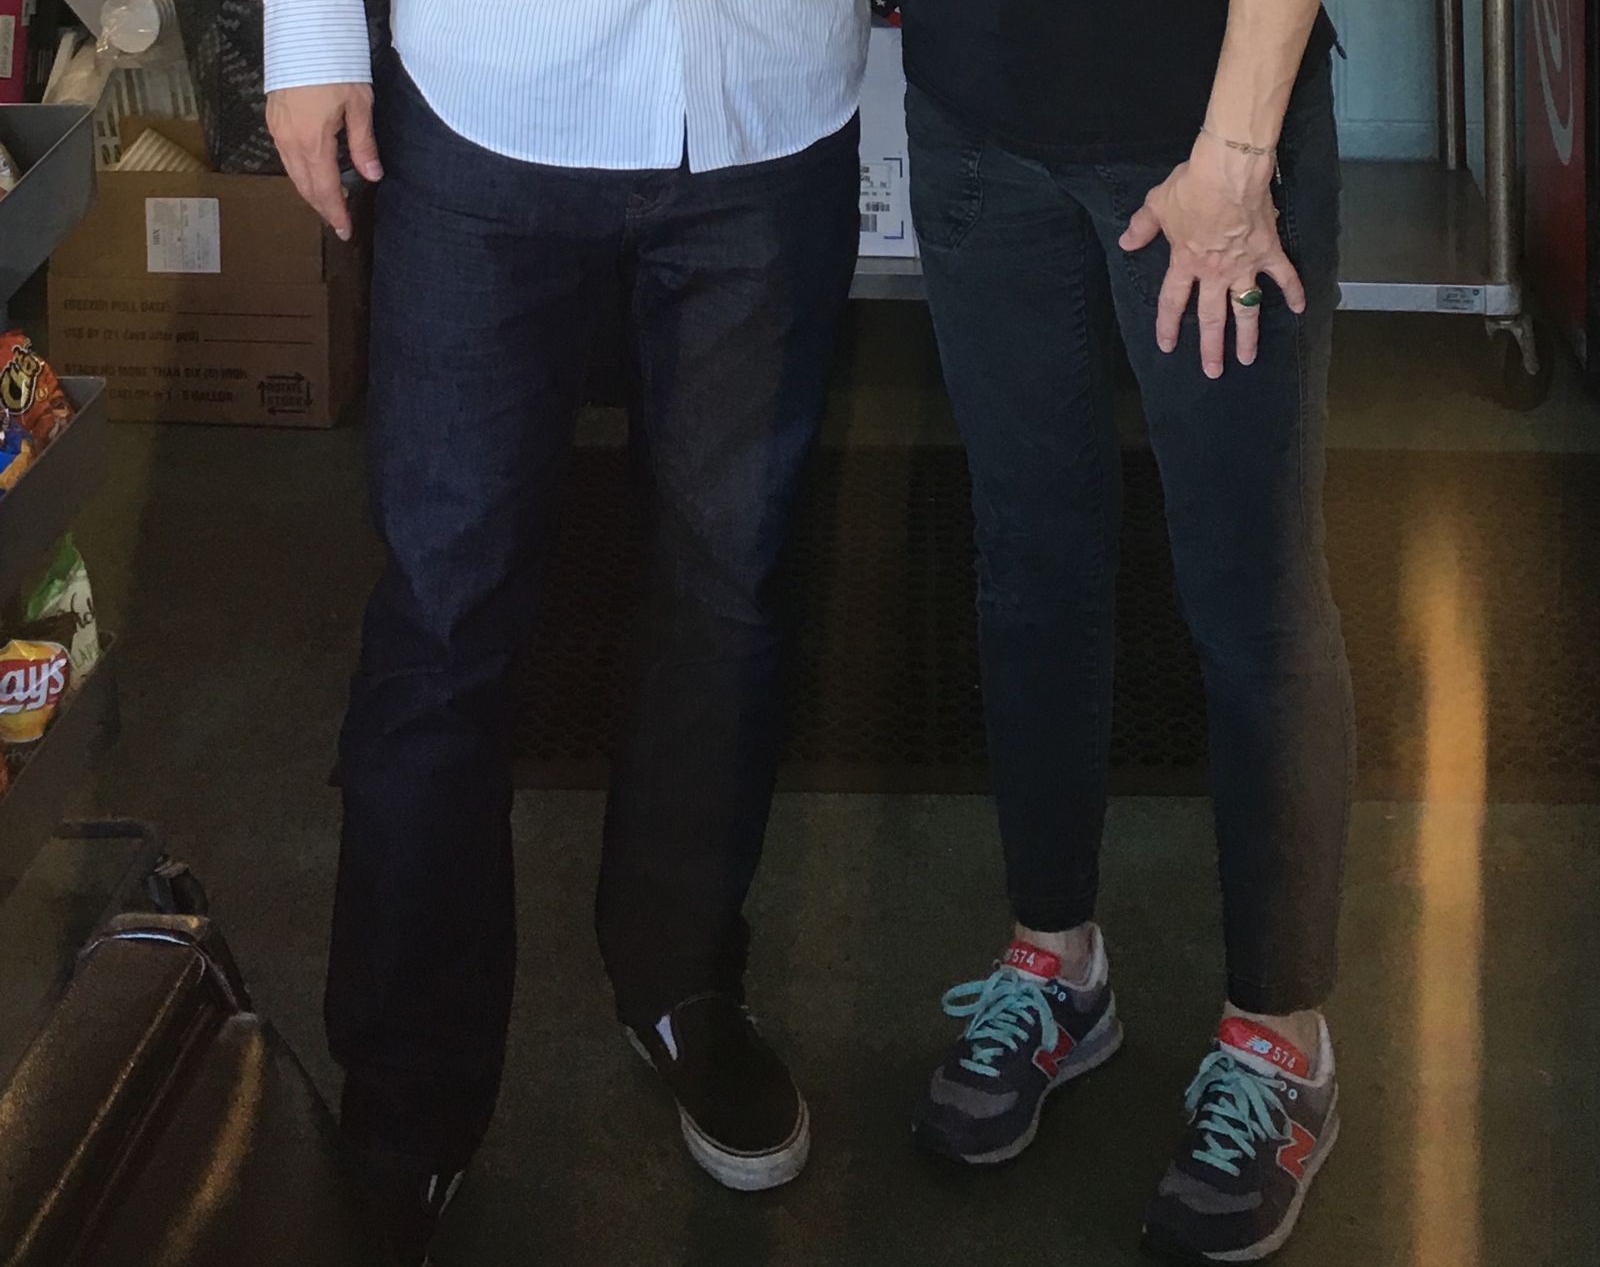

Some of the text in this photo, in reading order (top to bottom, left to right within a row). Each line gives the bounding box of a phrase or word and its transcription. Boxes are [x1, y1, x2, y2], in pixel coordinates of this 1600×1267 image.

[184, 367, 201, 379] SIX
[0, 655, 67, 714] ay's
[1012, 948, 1036, 967] 574
[1272, 1047, 1296, 1070] 574
